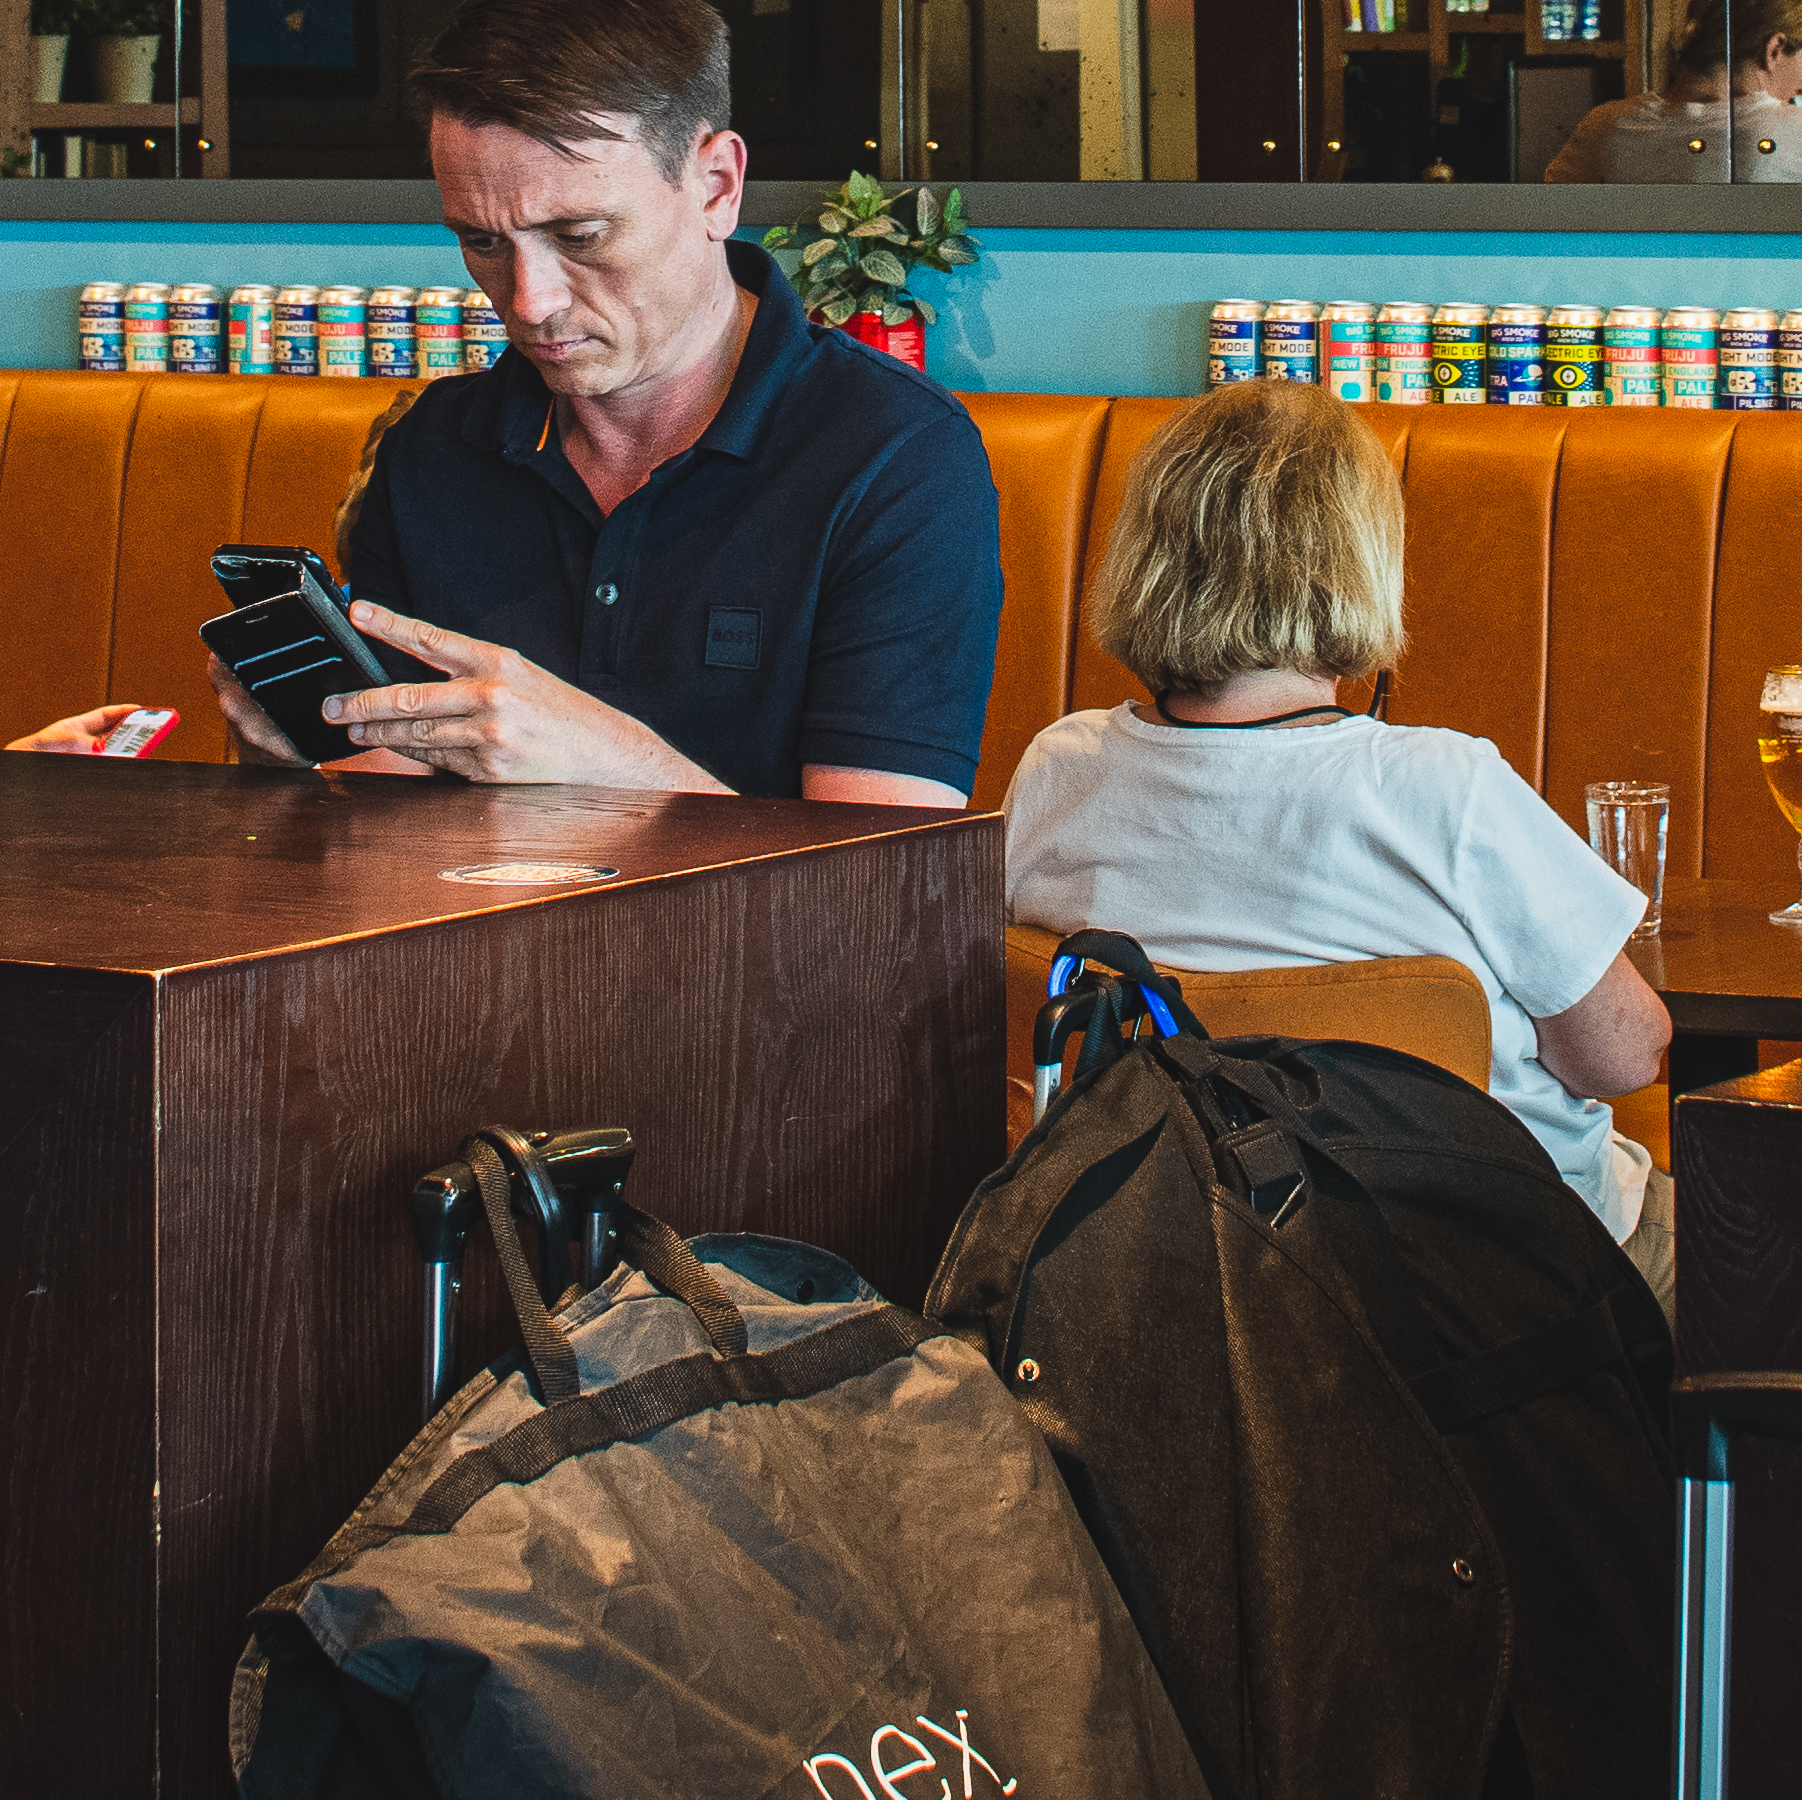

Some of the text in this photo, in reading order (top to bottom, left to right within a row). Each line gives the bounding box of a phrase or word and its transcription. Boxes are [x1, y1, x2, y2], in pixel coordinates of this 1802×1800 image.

[1504, 327, 1540, 338] SMOKE
[1560, 329, 1596, 340] SMOKE
[1733, 332, 1769, 343] SMOKE
[1218, 342, 1248, 352] MODE
[1280, 343, 1312, 353] MODE
[1383, 344, 1424, 355] FRUJU
[1462, 345, 1484, 356] EYE
[1677, 380, 1715, 393] PALE
[1454, 392, 1477, 402] ALE
[1631, 396, 1653, 406] ALE
[1681, 398, 1703, 408] ALE
